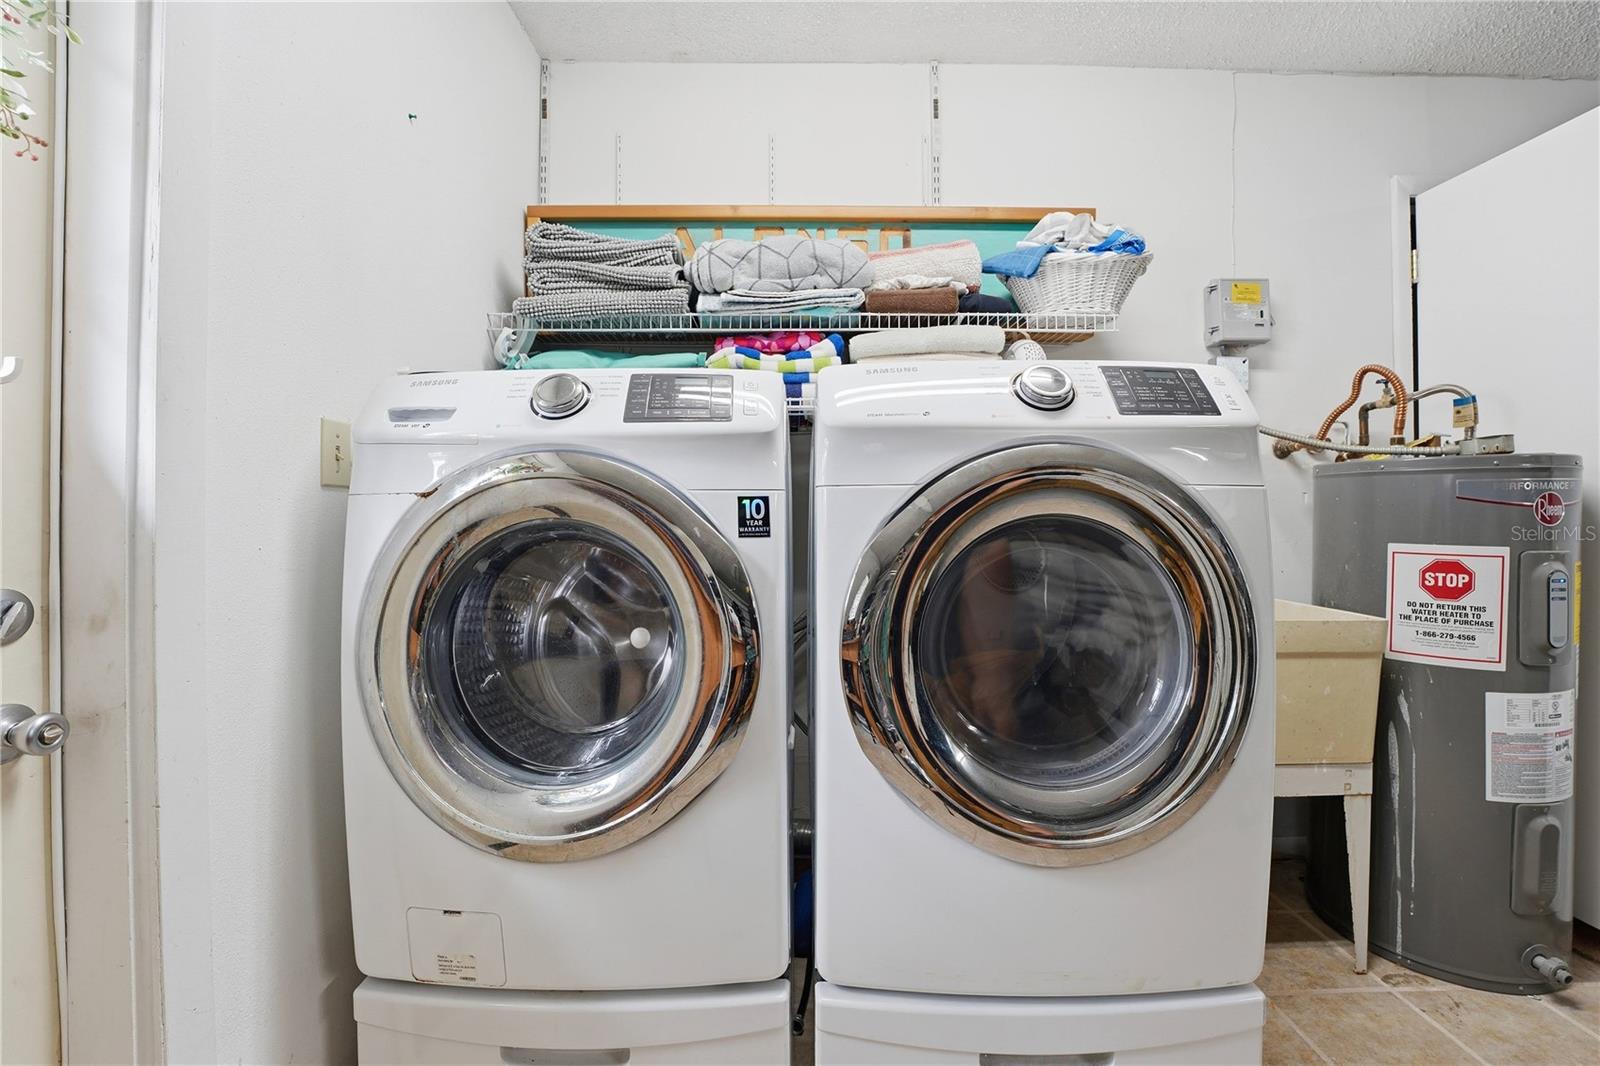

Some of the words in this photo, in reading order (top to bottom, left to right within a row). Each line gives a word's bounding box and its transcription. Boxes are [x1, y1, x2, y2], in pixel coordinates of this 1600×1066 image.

[866, 366, 919, 376] SAMSUNG
[410, 378, 459, 388] SAMSUNG
[1493, 481, 1569, 490] RFORMANCE
[742, 498, 765, 520] 10
[1424, 572, 1470, 588] STOP
[1411, 608, 1438, 616] WATER
[1439, 610, 1469, 619] HEATER
[1436, 603, 1467, 612] RETURN
[1469, 605, 1487, 613] THIS
[1399, 613, 1412, 621] THE
[1414, 615, 1439, 624] PLACE
[1440, 617, 1451, 625] OF
[1453, 618, 1495, 628] PURCHASE
[1415, 629, 1477, 642] 1-866-279-4566
